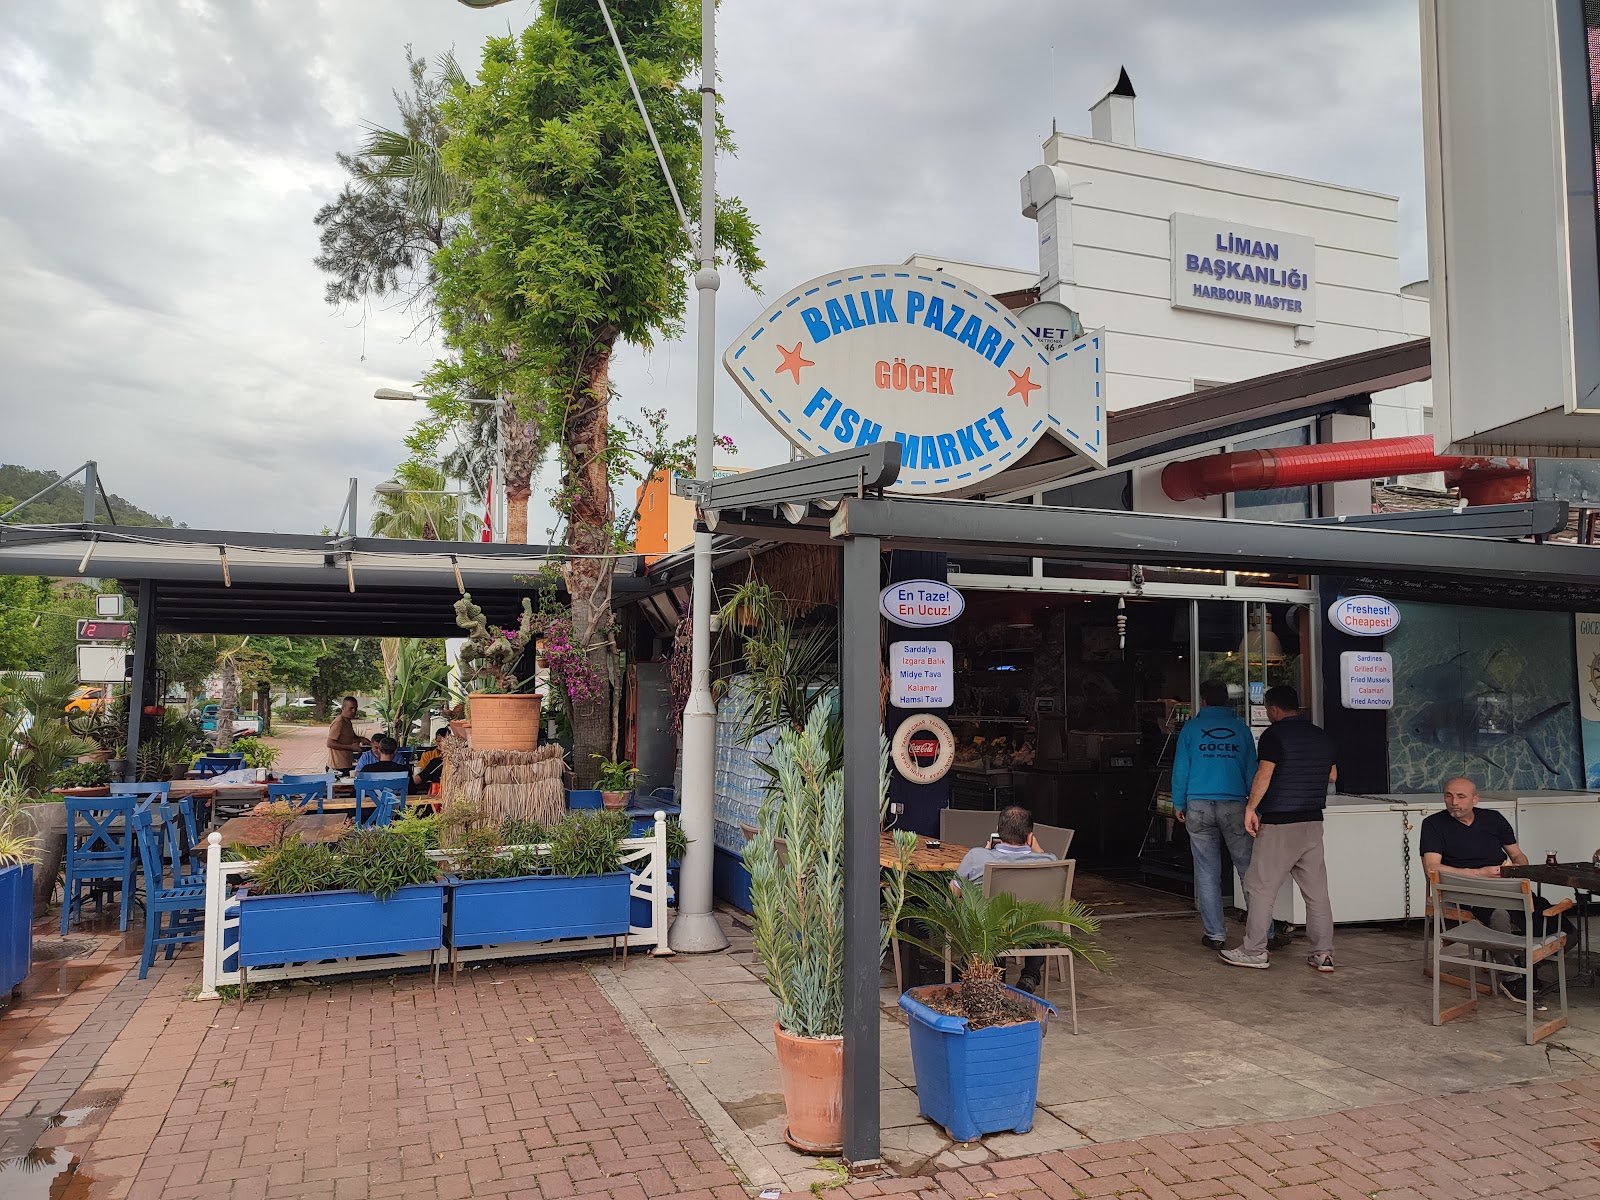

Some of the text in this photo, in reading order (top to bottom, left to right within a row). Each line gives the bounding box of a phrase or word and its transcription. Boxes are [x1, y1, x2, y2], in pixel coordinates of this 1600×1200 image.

[1216, 232, 1279, 262] LİMAN
[1185, 253, 1308, 290] BAŞKANLIĞI
[1193, 283, 1303, 313] HARBOUR MASTER
[800, 288, 1015, 369] BALIK PAZARI
[874, 356, 954, 396] GÖCEK
[802, 386, 1013, 470] FISH MARKET
[898, 589, 949, 603] En Taze!
[899, 604, 951, 617] En Ucuz!
[1346, 603, 1390, 616] Freshest!
[1344, 615, 1392, 629] Cheapest!
[904, 645, 937, 655] Sardalya
[1357, 654, 1383, 662] Sardines
[900, 670, 942, 680] Midye Tava
[1354, 665, 1374, 673] Grilled
[1366, 676, 1391, 684] Mussels
[907, 684, 938, 692] Kalamar
[925, 695, 943, 703] Tava
[1351, 697, 1392, 707] Fried Anchovy
